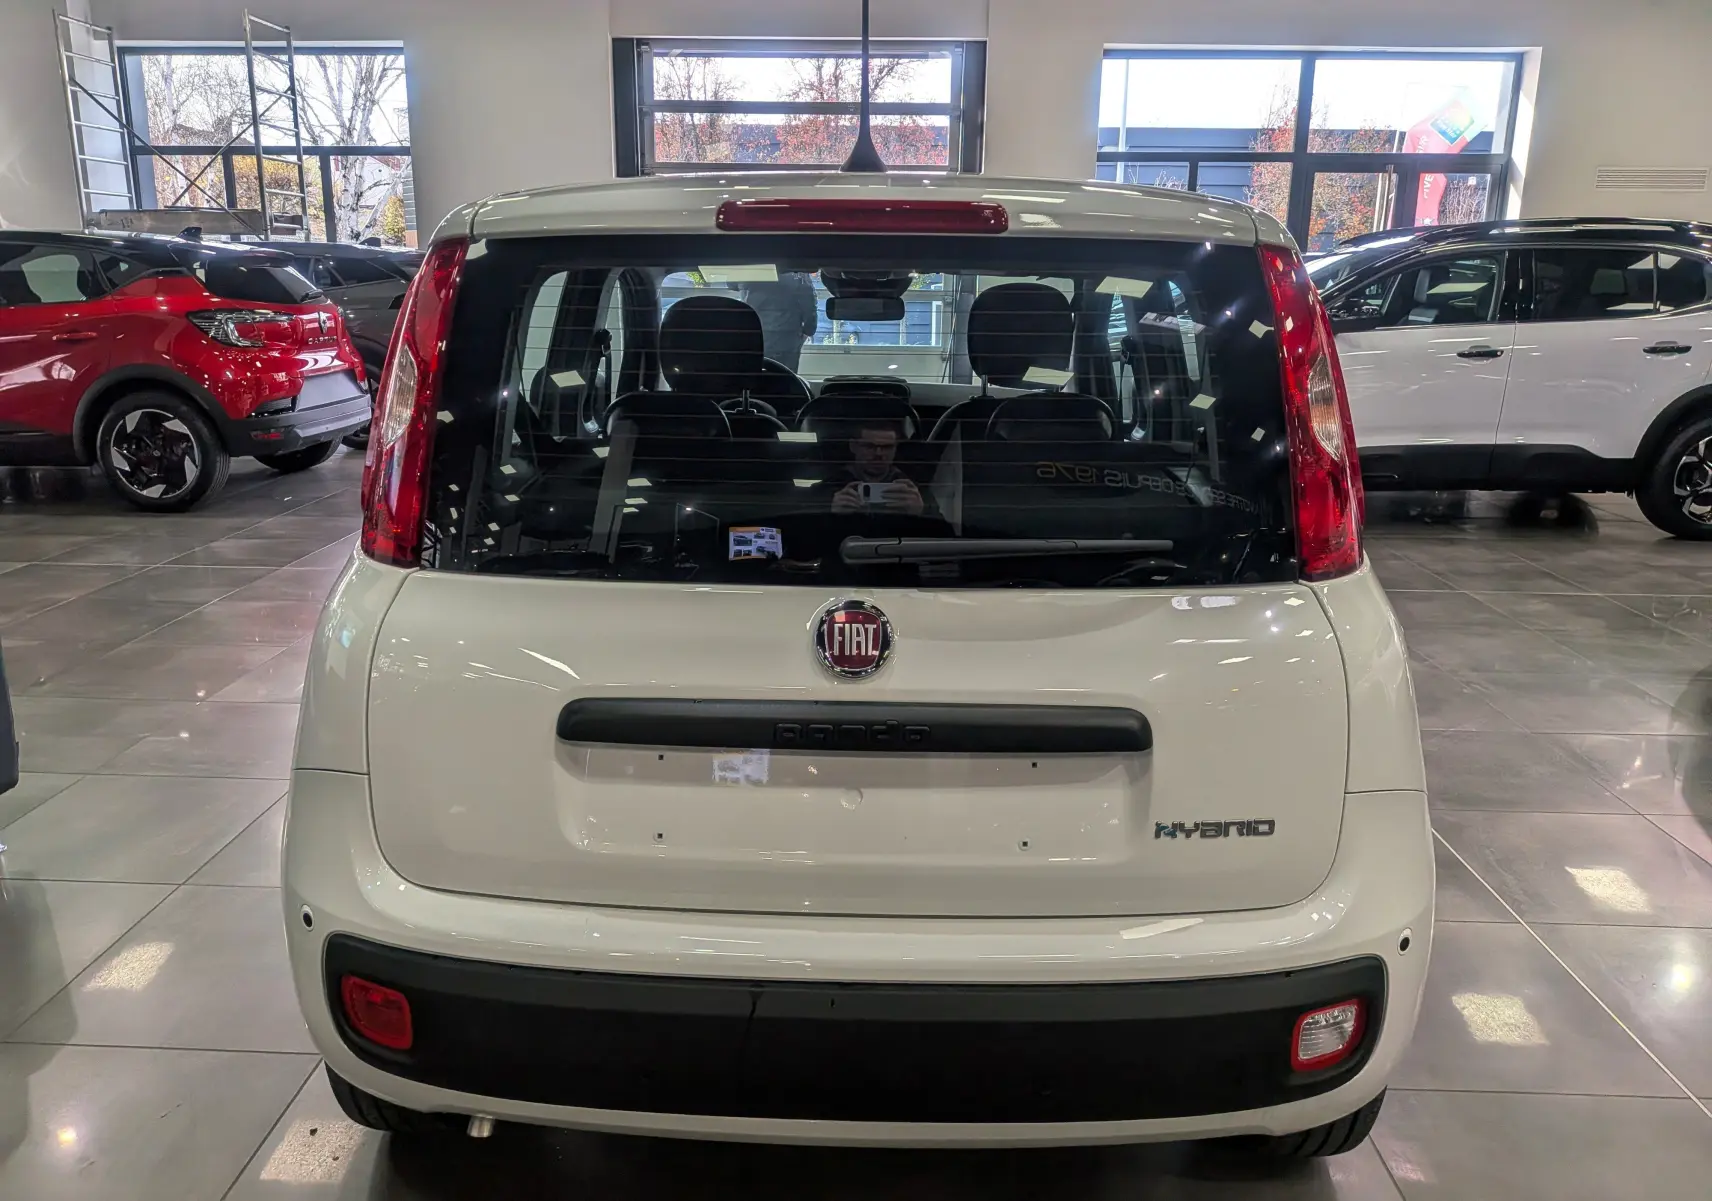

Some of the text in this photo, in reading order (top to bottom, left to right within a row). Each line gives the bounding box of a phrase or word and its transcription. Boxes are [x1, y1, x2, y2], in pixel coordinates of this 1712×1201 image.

[308, 335, 338, 345] CAPTUR
[833, 623, 877, 656] FIAT
[1154, 818, 1276, 839] HYBRID
